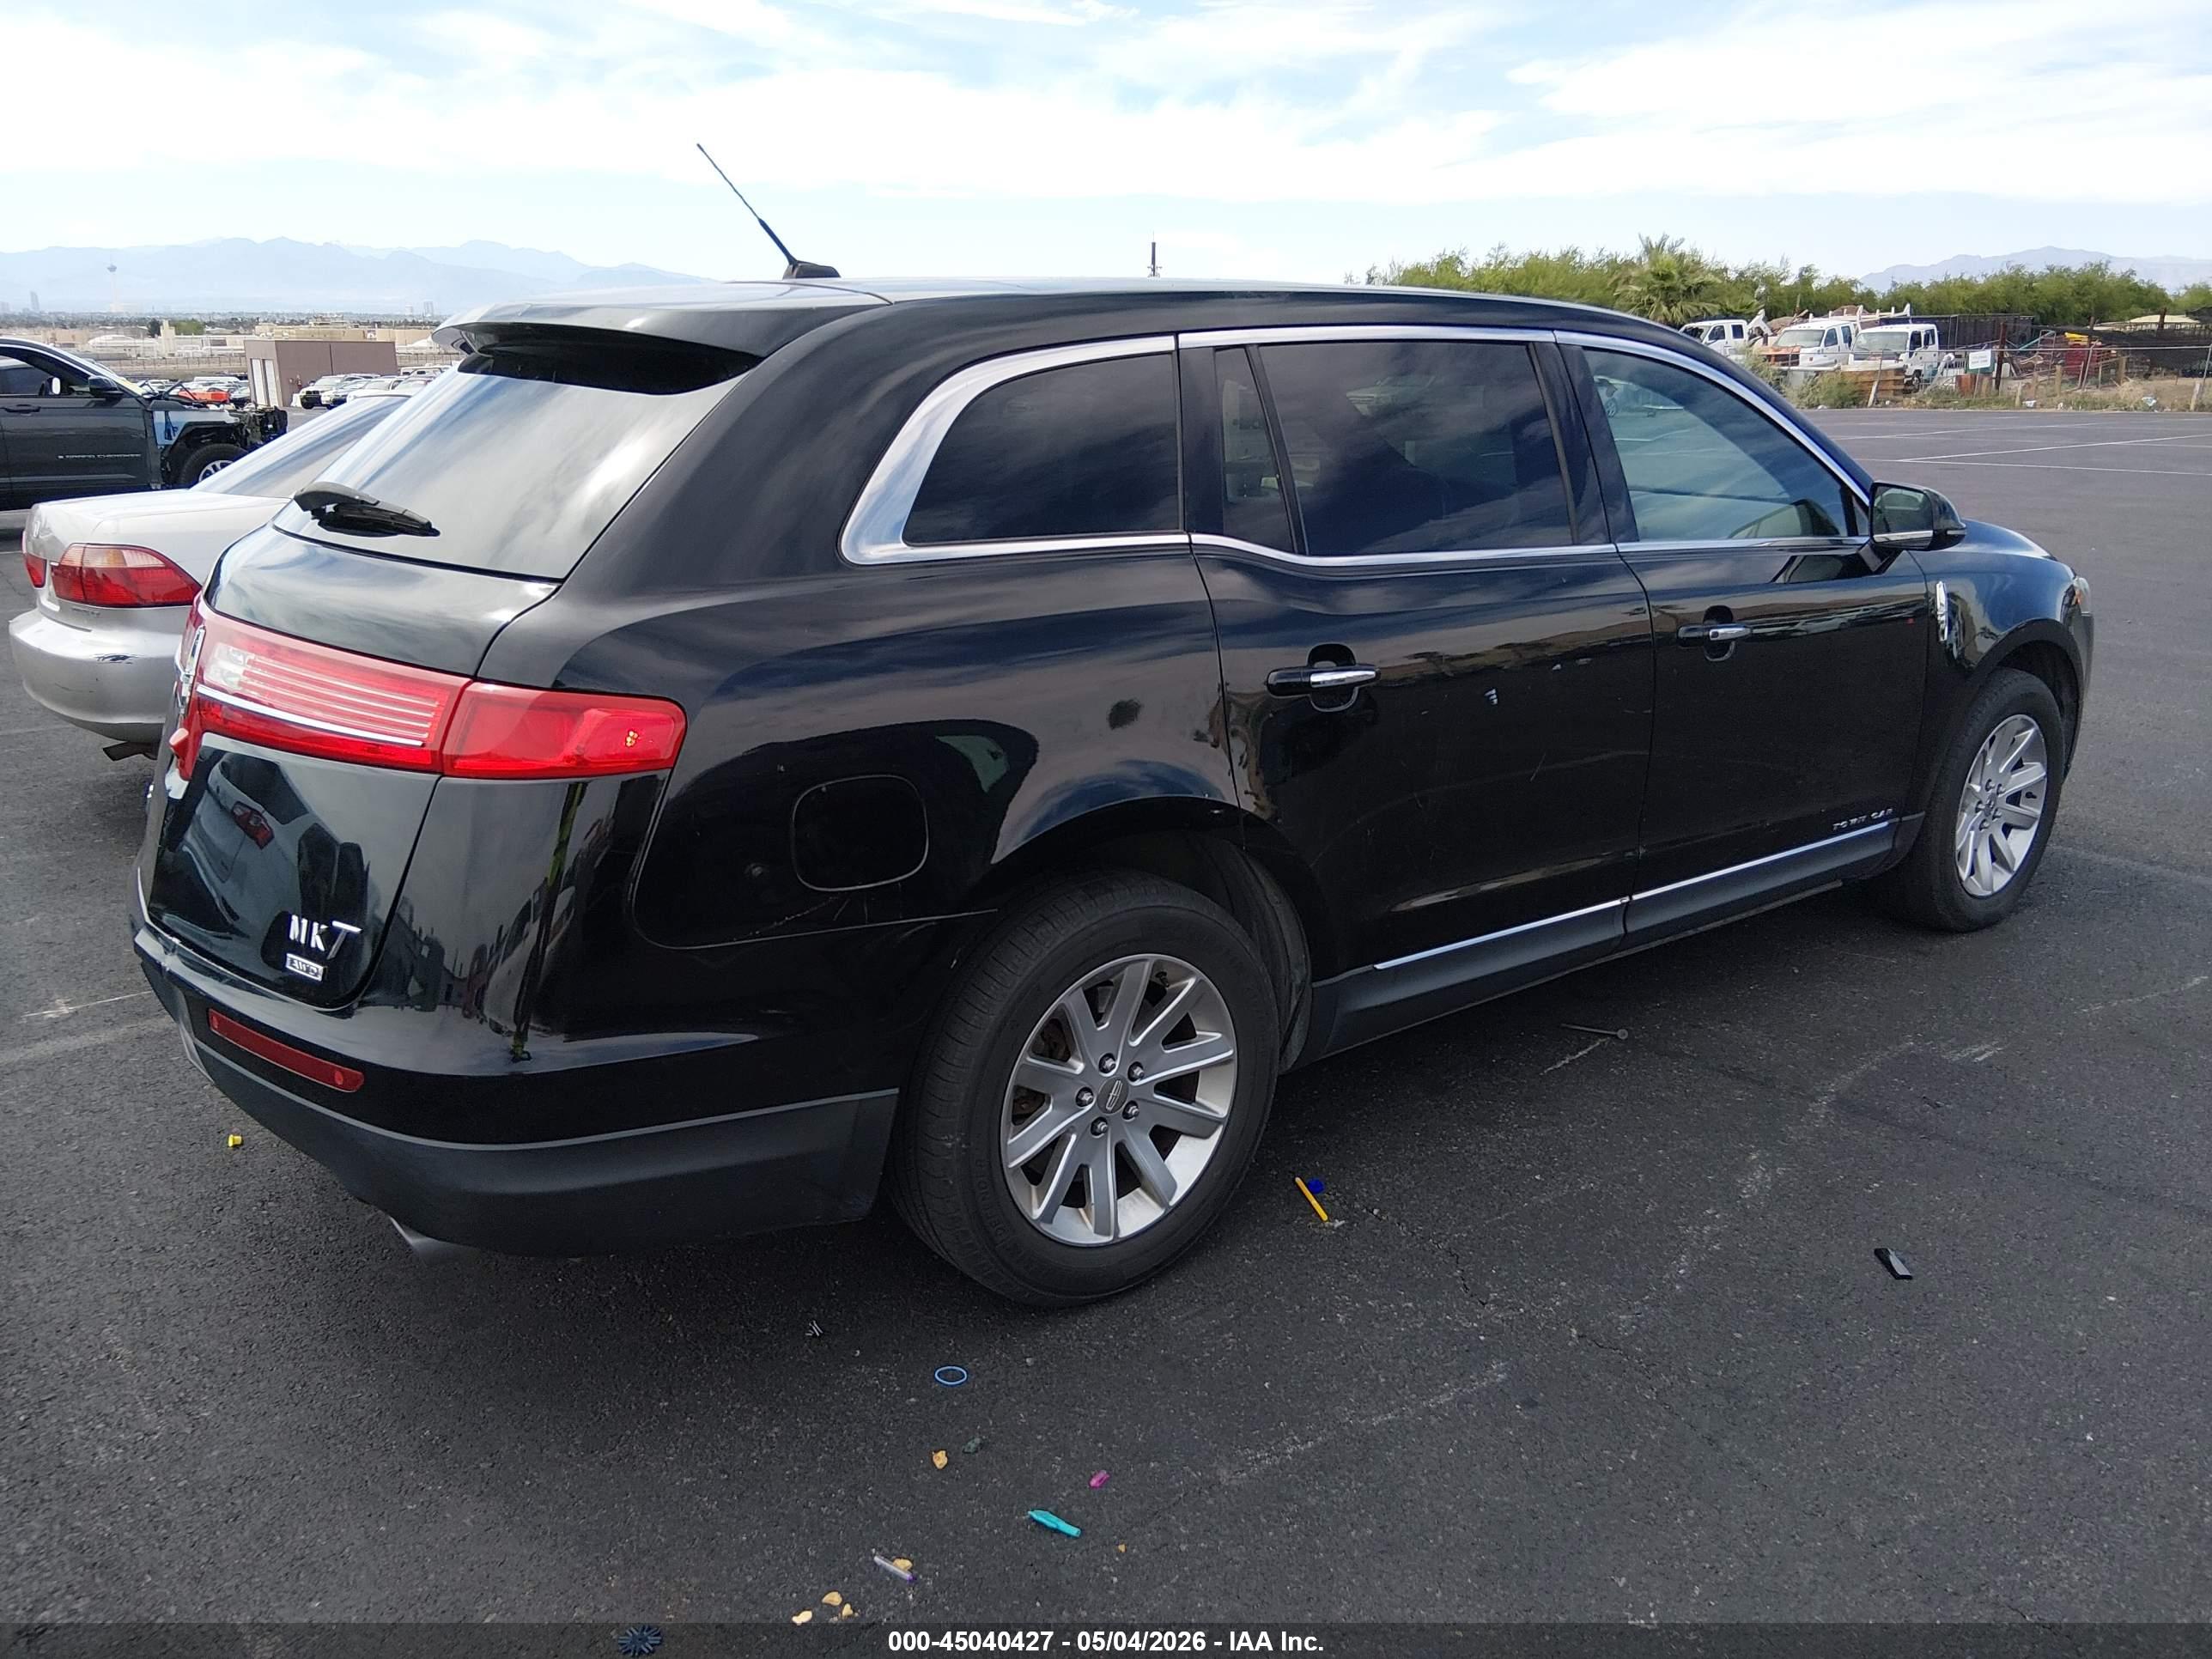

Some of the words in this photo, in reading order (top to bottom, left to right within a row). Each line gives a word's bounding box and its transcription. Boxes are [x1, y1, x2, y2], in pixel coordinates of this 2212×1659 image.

[1871, 808, 1893, 820] CAR
[289, 914, 363, 960] MKT
[292, 958, 319, 976] AWD
